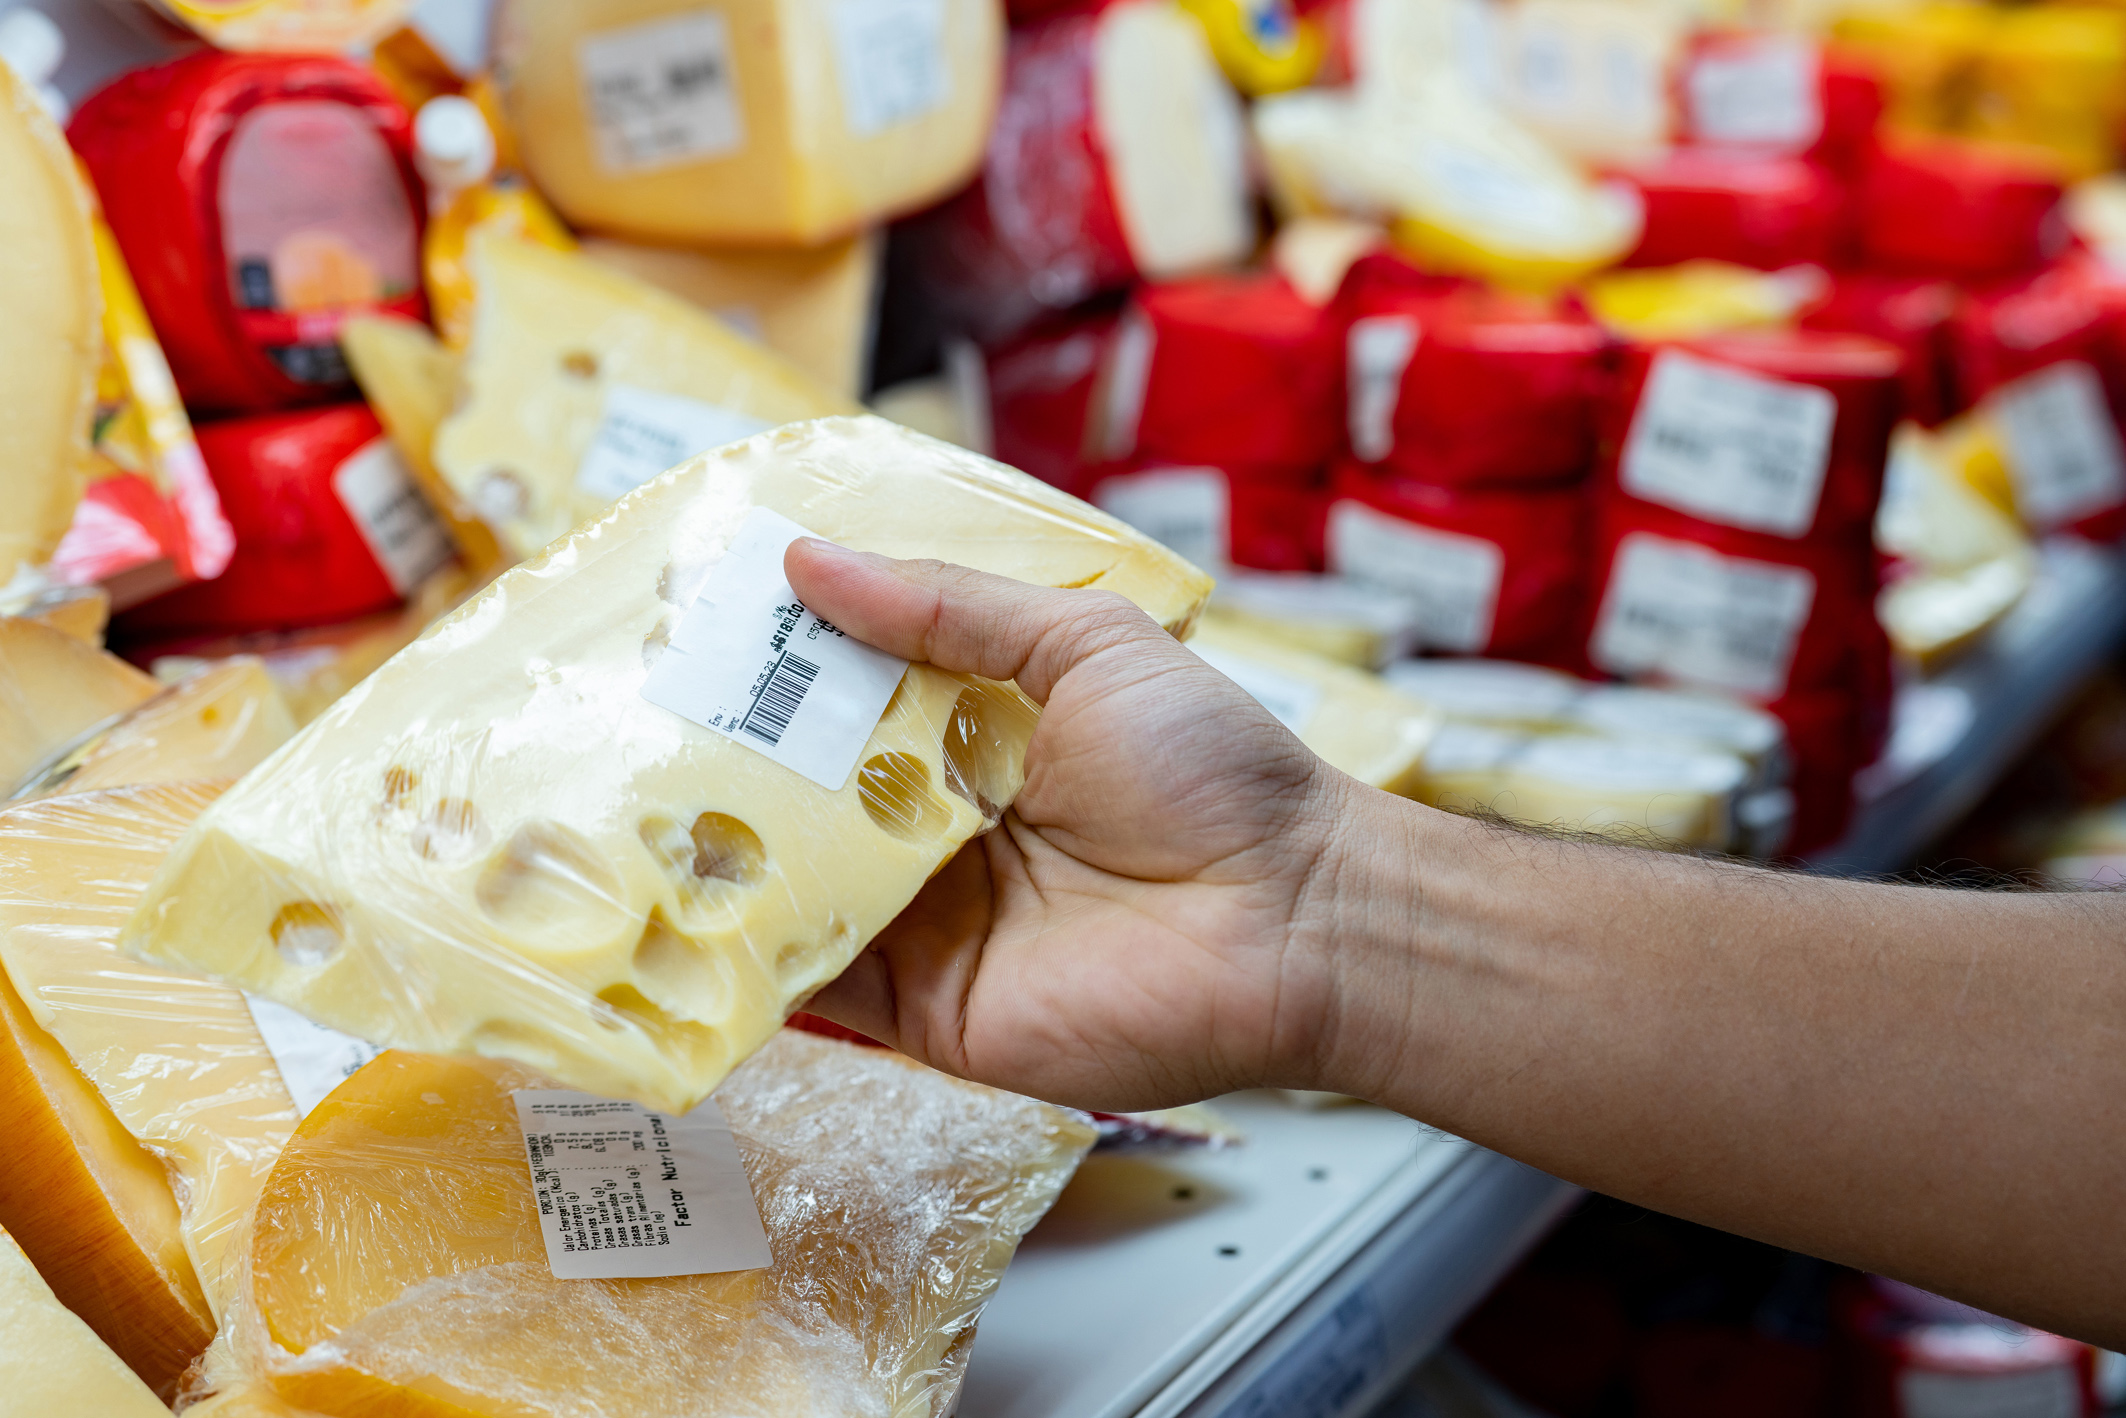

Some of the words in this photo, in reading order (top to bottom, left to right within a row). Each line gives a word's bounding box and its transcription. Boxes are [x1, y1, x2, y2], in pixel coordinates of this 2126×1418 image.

[644, 1114, 679, 1181] Nutricional
[590, 1187, 605, 1198] (g)
[602, 1179, 617, 1190] (g)
[565, 1192, 580, 1203] (g)
[607, 1193, 624, 1224] saturadas
[618, 1192, 633, 1203] (g)
[632, 1181, 650, 1221] Alimentarias
[669, 1188, 692, 1227] Factor
[582, 1204, 597, 1215] (g)
[597, 1201, 611, 1225] Totales
[625, 1205, 637, 1222] trans
[571, 1204, 589, 1252] Carbohidratos
[588, 1218, 603, 1250] Proteinas
[604, 1227, 617, 1249] Grasas
[617, 1226, 630, 1248] Grasas
[631, 1225, 643, 1247] Grasas
[643, 1223, 656, 1247] Fibras
[656, 1226, 670, 1246] Sodio
